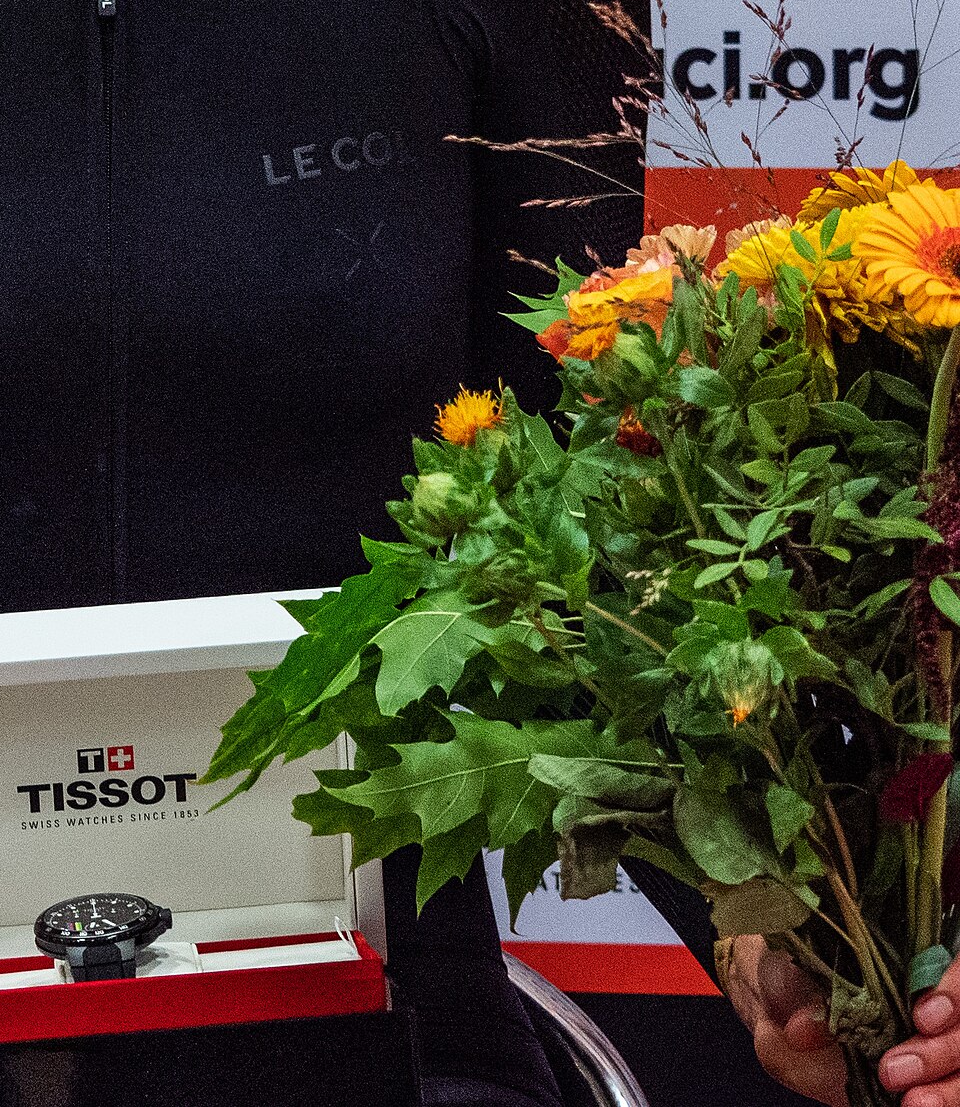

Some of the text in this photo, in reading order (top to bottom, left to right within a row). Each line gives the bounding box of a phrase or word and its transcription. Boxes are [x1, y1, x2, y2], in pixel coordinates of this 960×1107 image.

[262, 143, 322, 185] LE
[17, 773, 197, 813] TISSOT
[21, 808, 200, 831] SWISS WATCHES SINCE 1853
